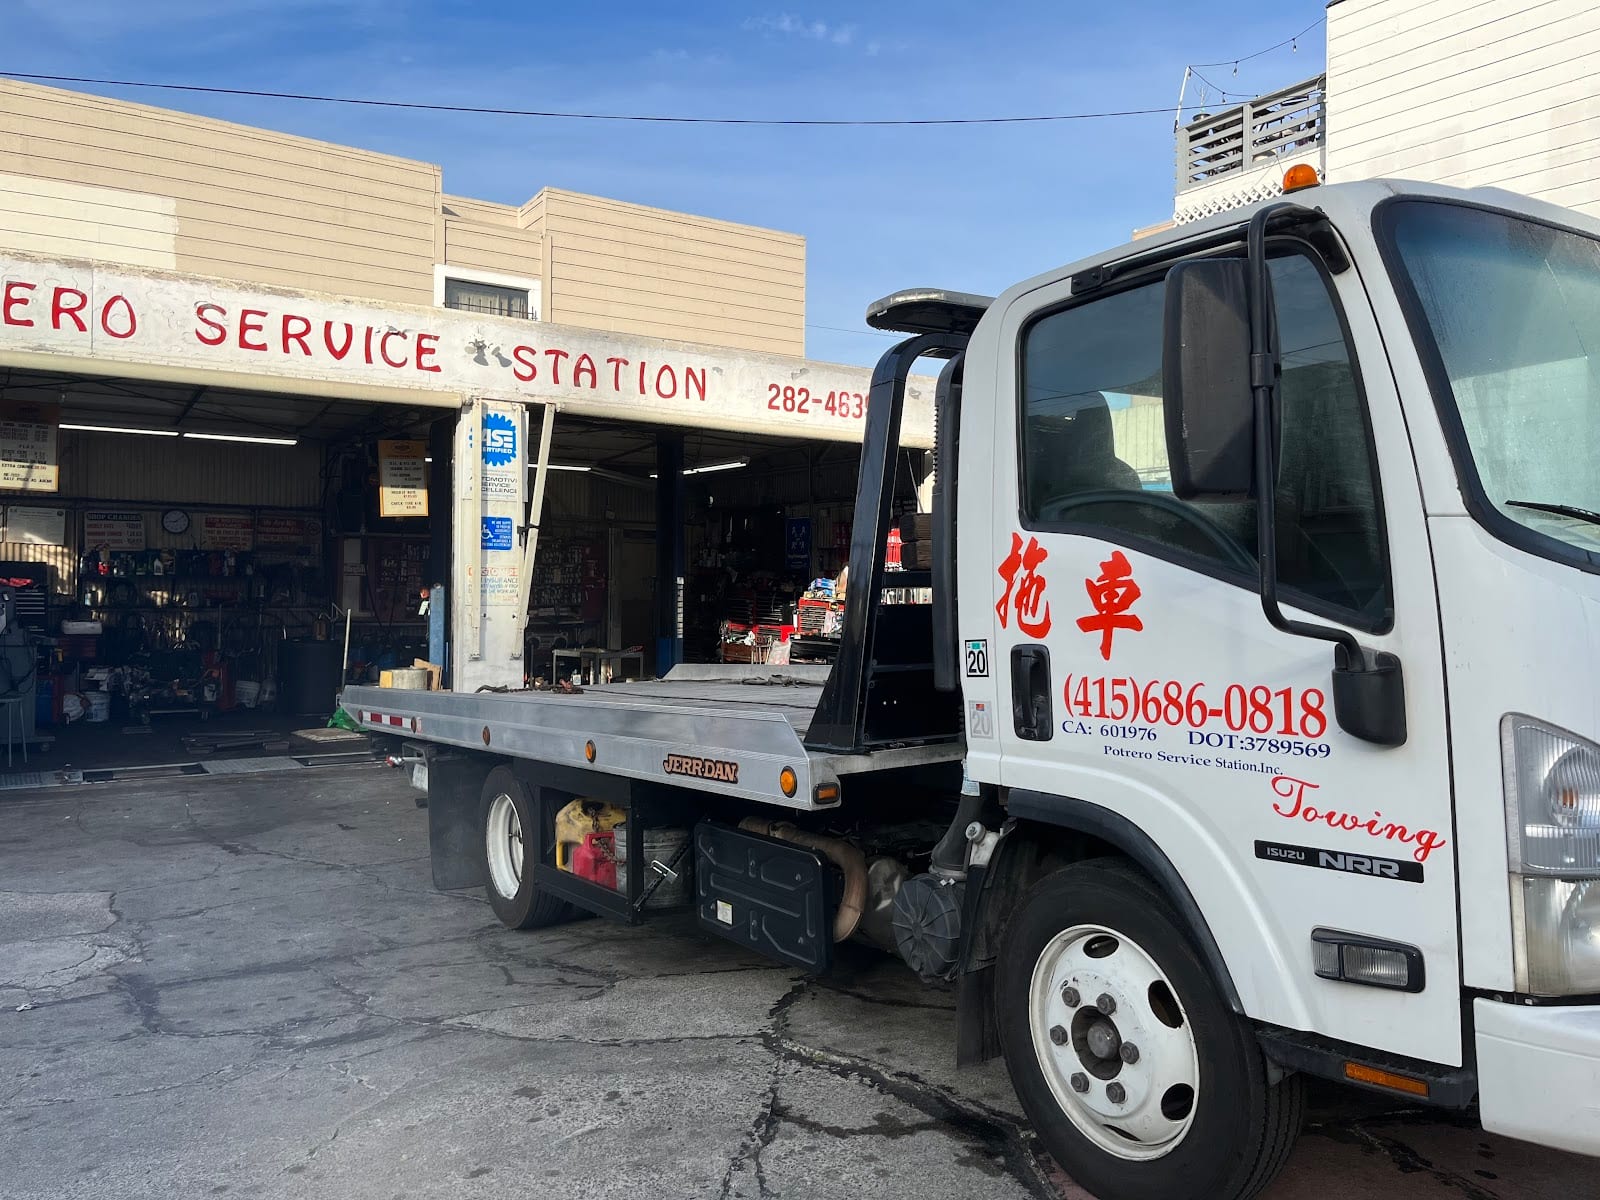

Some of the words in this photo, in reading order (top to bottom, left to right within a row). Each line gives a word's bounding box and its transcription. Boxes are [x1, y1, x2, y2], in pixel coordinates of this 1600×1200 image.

[3, 282, 137, 339] ERO
[195, 303, 442, 373] SERVICE
[513, 345, 707, 401] STATION
[967, 650, 986, 674] 20
[1063, 672, 1328, 739] (415)686-0818
[1061, 720, 1092, 735] CA:
[1100, 724, 1157, 741] 601976
[1187, 731, 1331, 759] DOT:3789569
[1103, 745, 1153, 760] Potrero
[1157, 750, 1212, 768] Service
[1270, 775, 1447, 863] Towing
[1265, 846, 1306, 861] ISUZU
[1317, 850, 1401, 878] NRR
